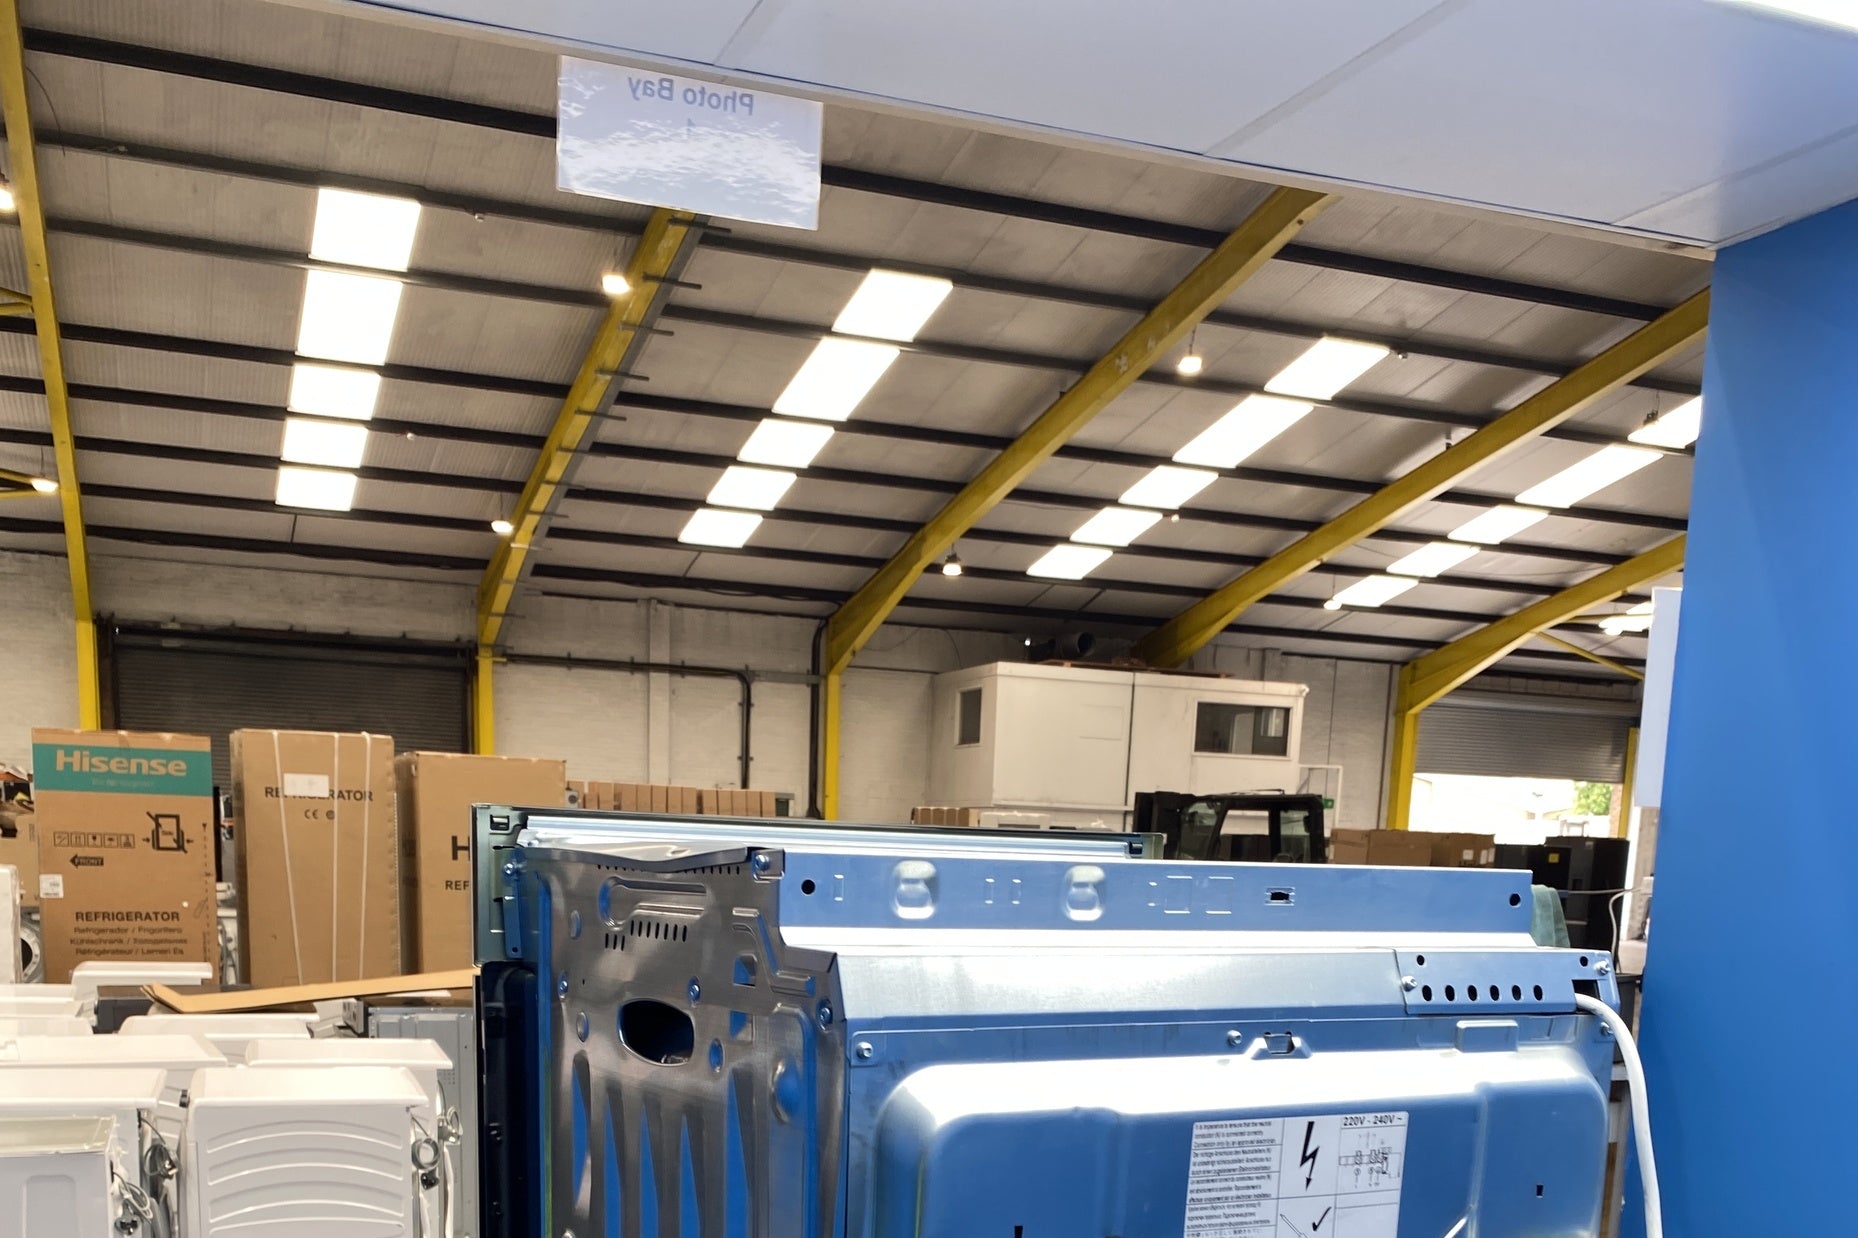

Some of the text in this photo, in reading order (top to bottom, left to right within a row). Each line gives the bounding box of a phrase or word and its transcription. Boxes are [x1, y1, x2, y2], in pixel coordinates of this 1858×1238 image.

[56, 748, 188, 777] Hisense
[264, 786, 374, 802] RERATOR
[74, 911, 181, 922] REFRIGERATOR
[1343, 1116, 1366, 1127] 220V
[1372, 1114, 1395, 1125] 240V
